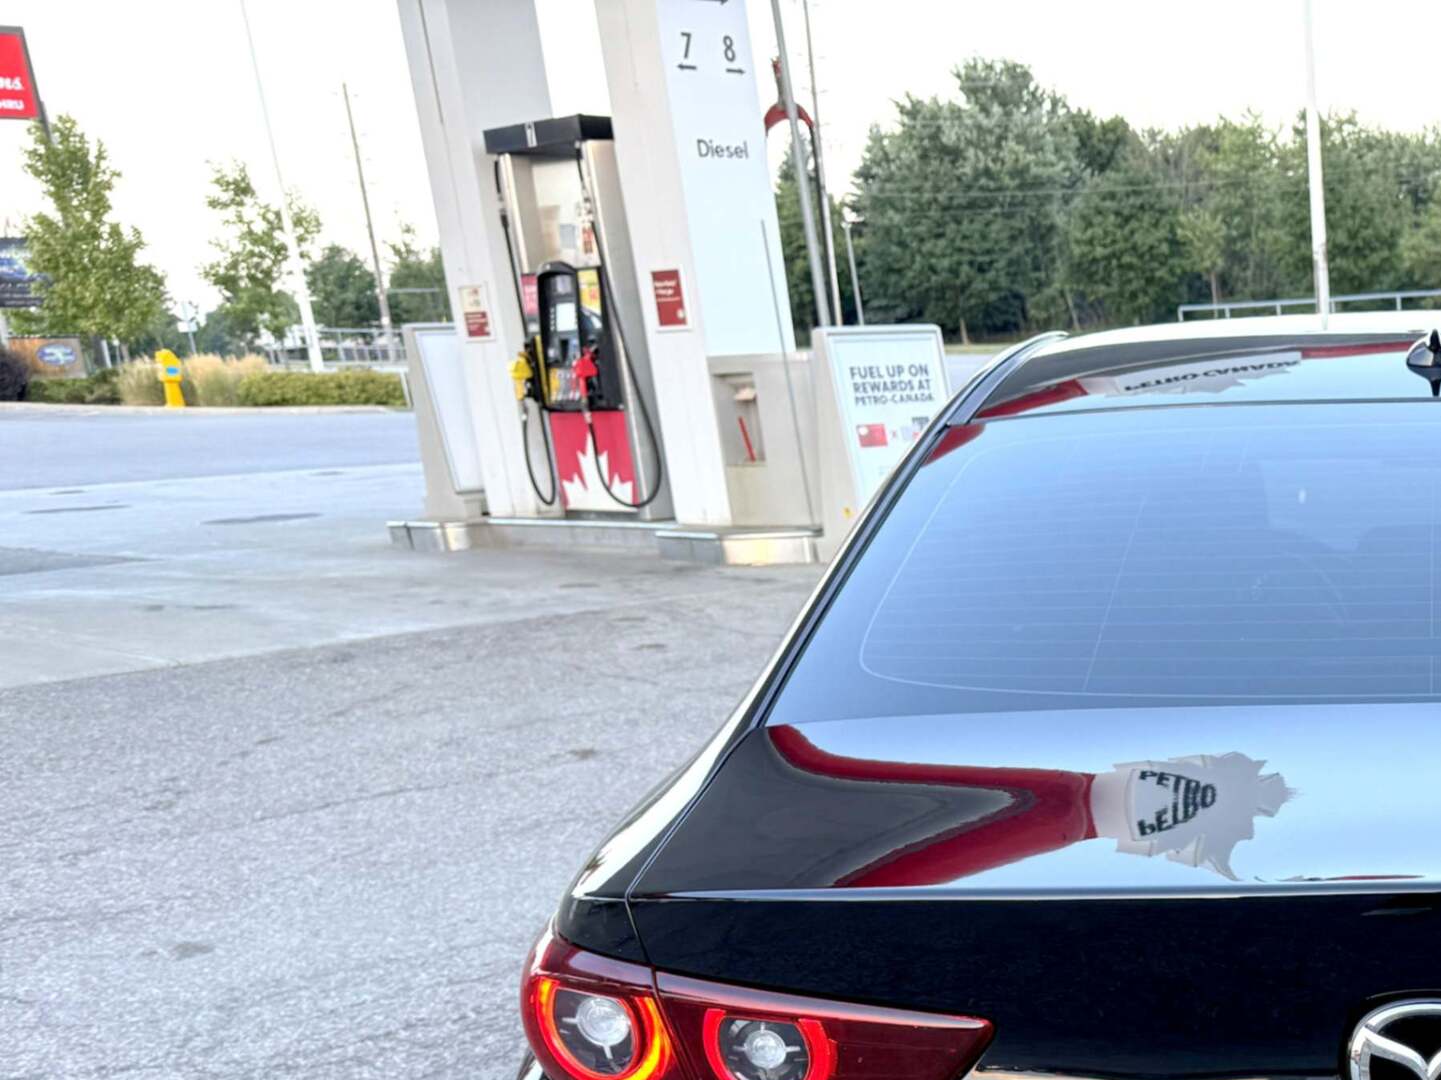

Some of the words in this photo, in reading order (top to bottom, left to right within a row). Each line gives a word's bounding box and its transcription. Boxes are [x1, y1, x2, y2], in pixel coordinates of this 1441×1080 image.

[681, 32, 691, 59] 7
[723, 35, 736, 63] 8
[697, 138, 750, 159] Diesel
[849, 366, 884, 380] FUEL
[886, 365, 904, 378] UP
[908, 363, 929, 377] ON
[853, 380, 915, 394] REWARDS
[918, 378, 931, 391] AT
[855, 392, 935, 406] PETRO-CANADA
